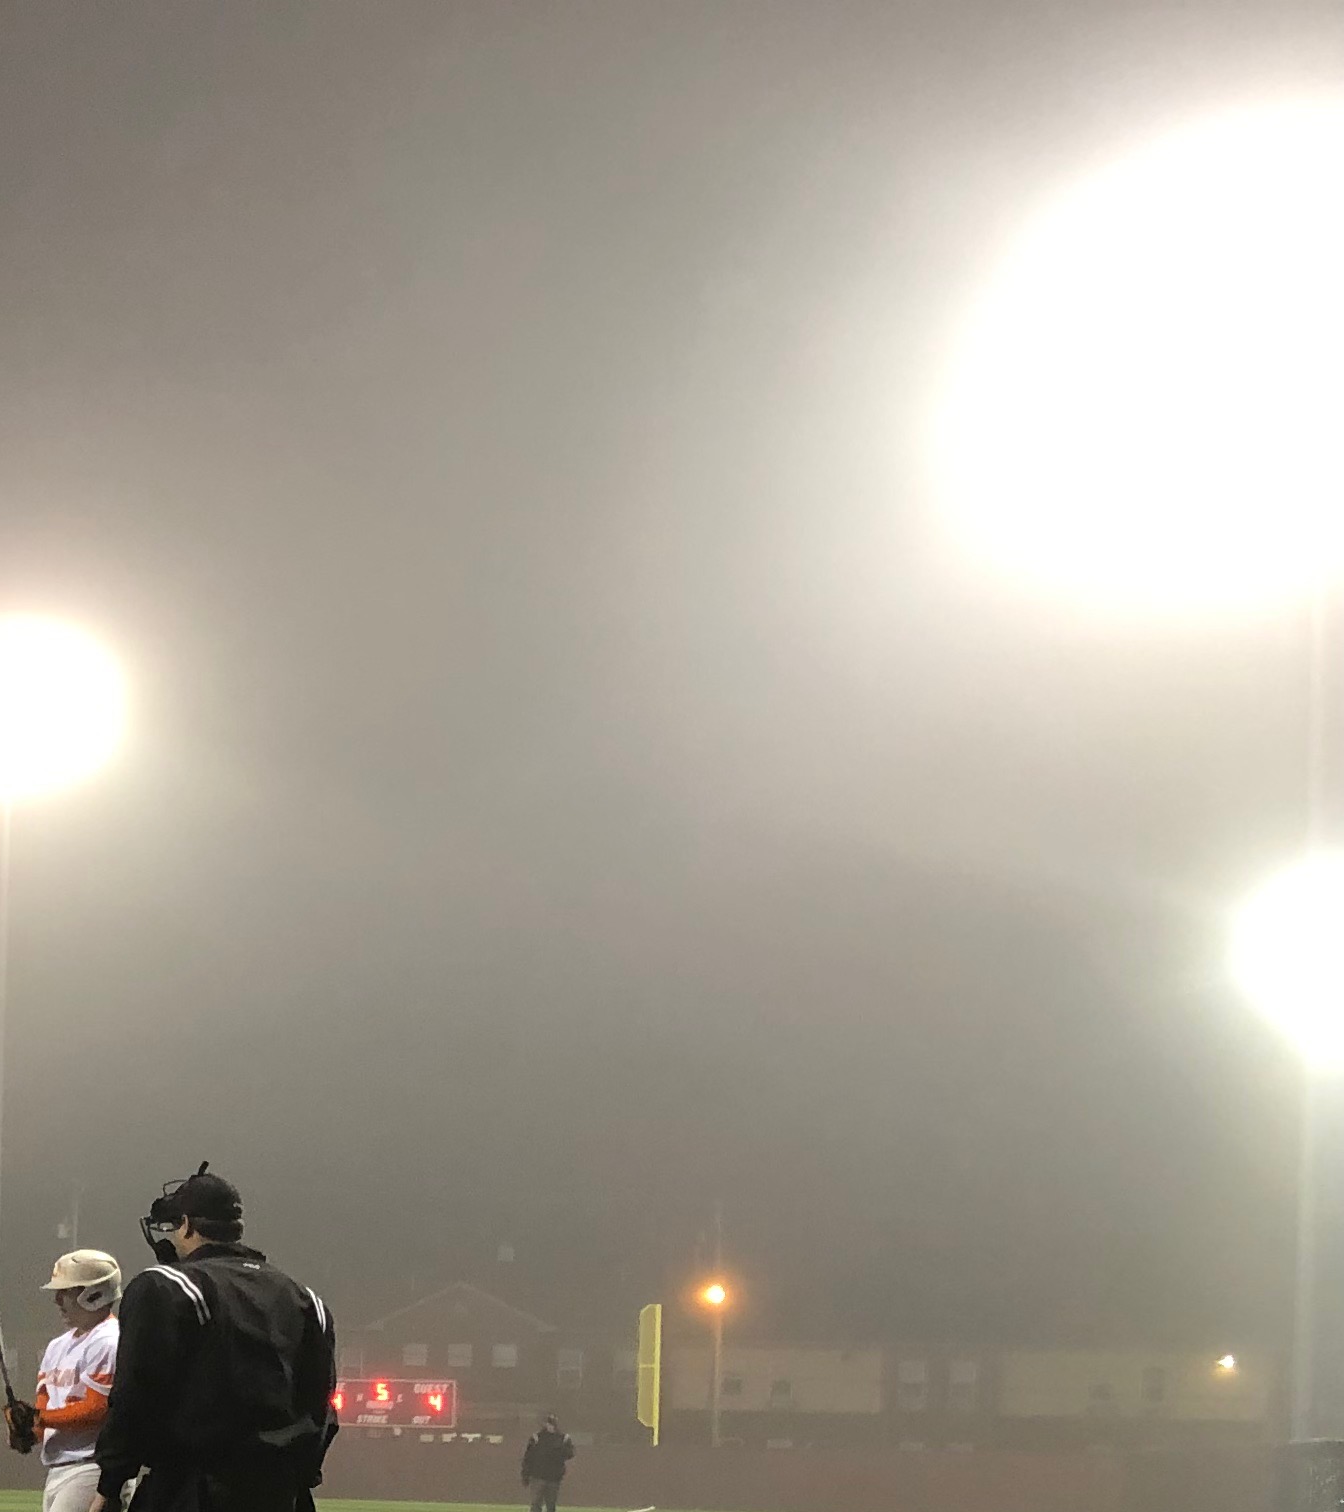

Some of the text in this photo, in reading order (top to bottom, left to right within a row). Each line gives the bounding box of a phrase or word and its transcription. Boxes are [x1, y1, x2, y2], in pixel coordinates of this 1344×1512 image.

[376, 1383, 389, 1401] 5
[428, 1394, 442, 1412] 4
[357, 1414, 389, 1424] STRIKE
